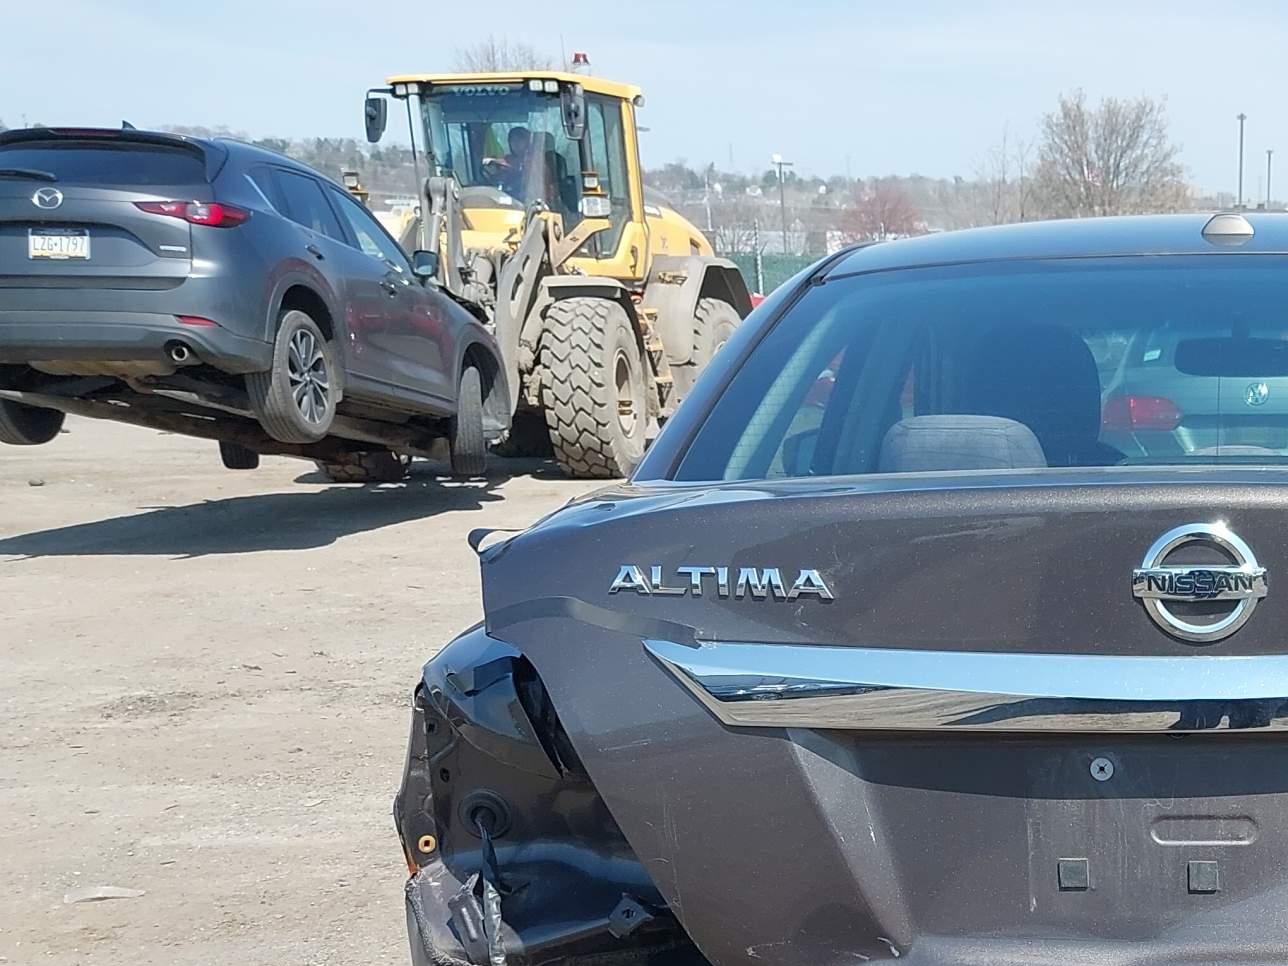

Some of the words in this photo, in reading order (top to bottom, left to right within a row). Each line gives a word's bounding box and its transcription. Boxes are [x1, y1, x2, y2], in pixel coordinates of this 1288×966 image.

[451, 86, 510, 96] VOLVO
[608, 565, 834, 600] ALTIMA
[1145, 572, 1254, 594] NISSAN
